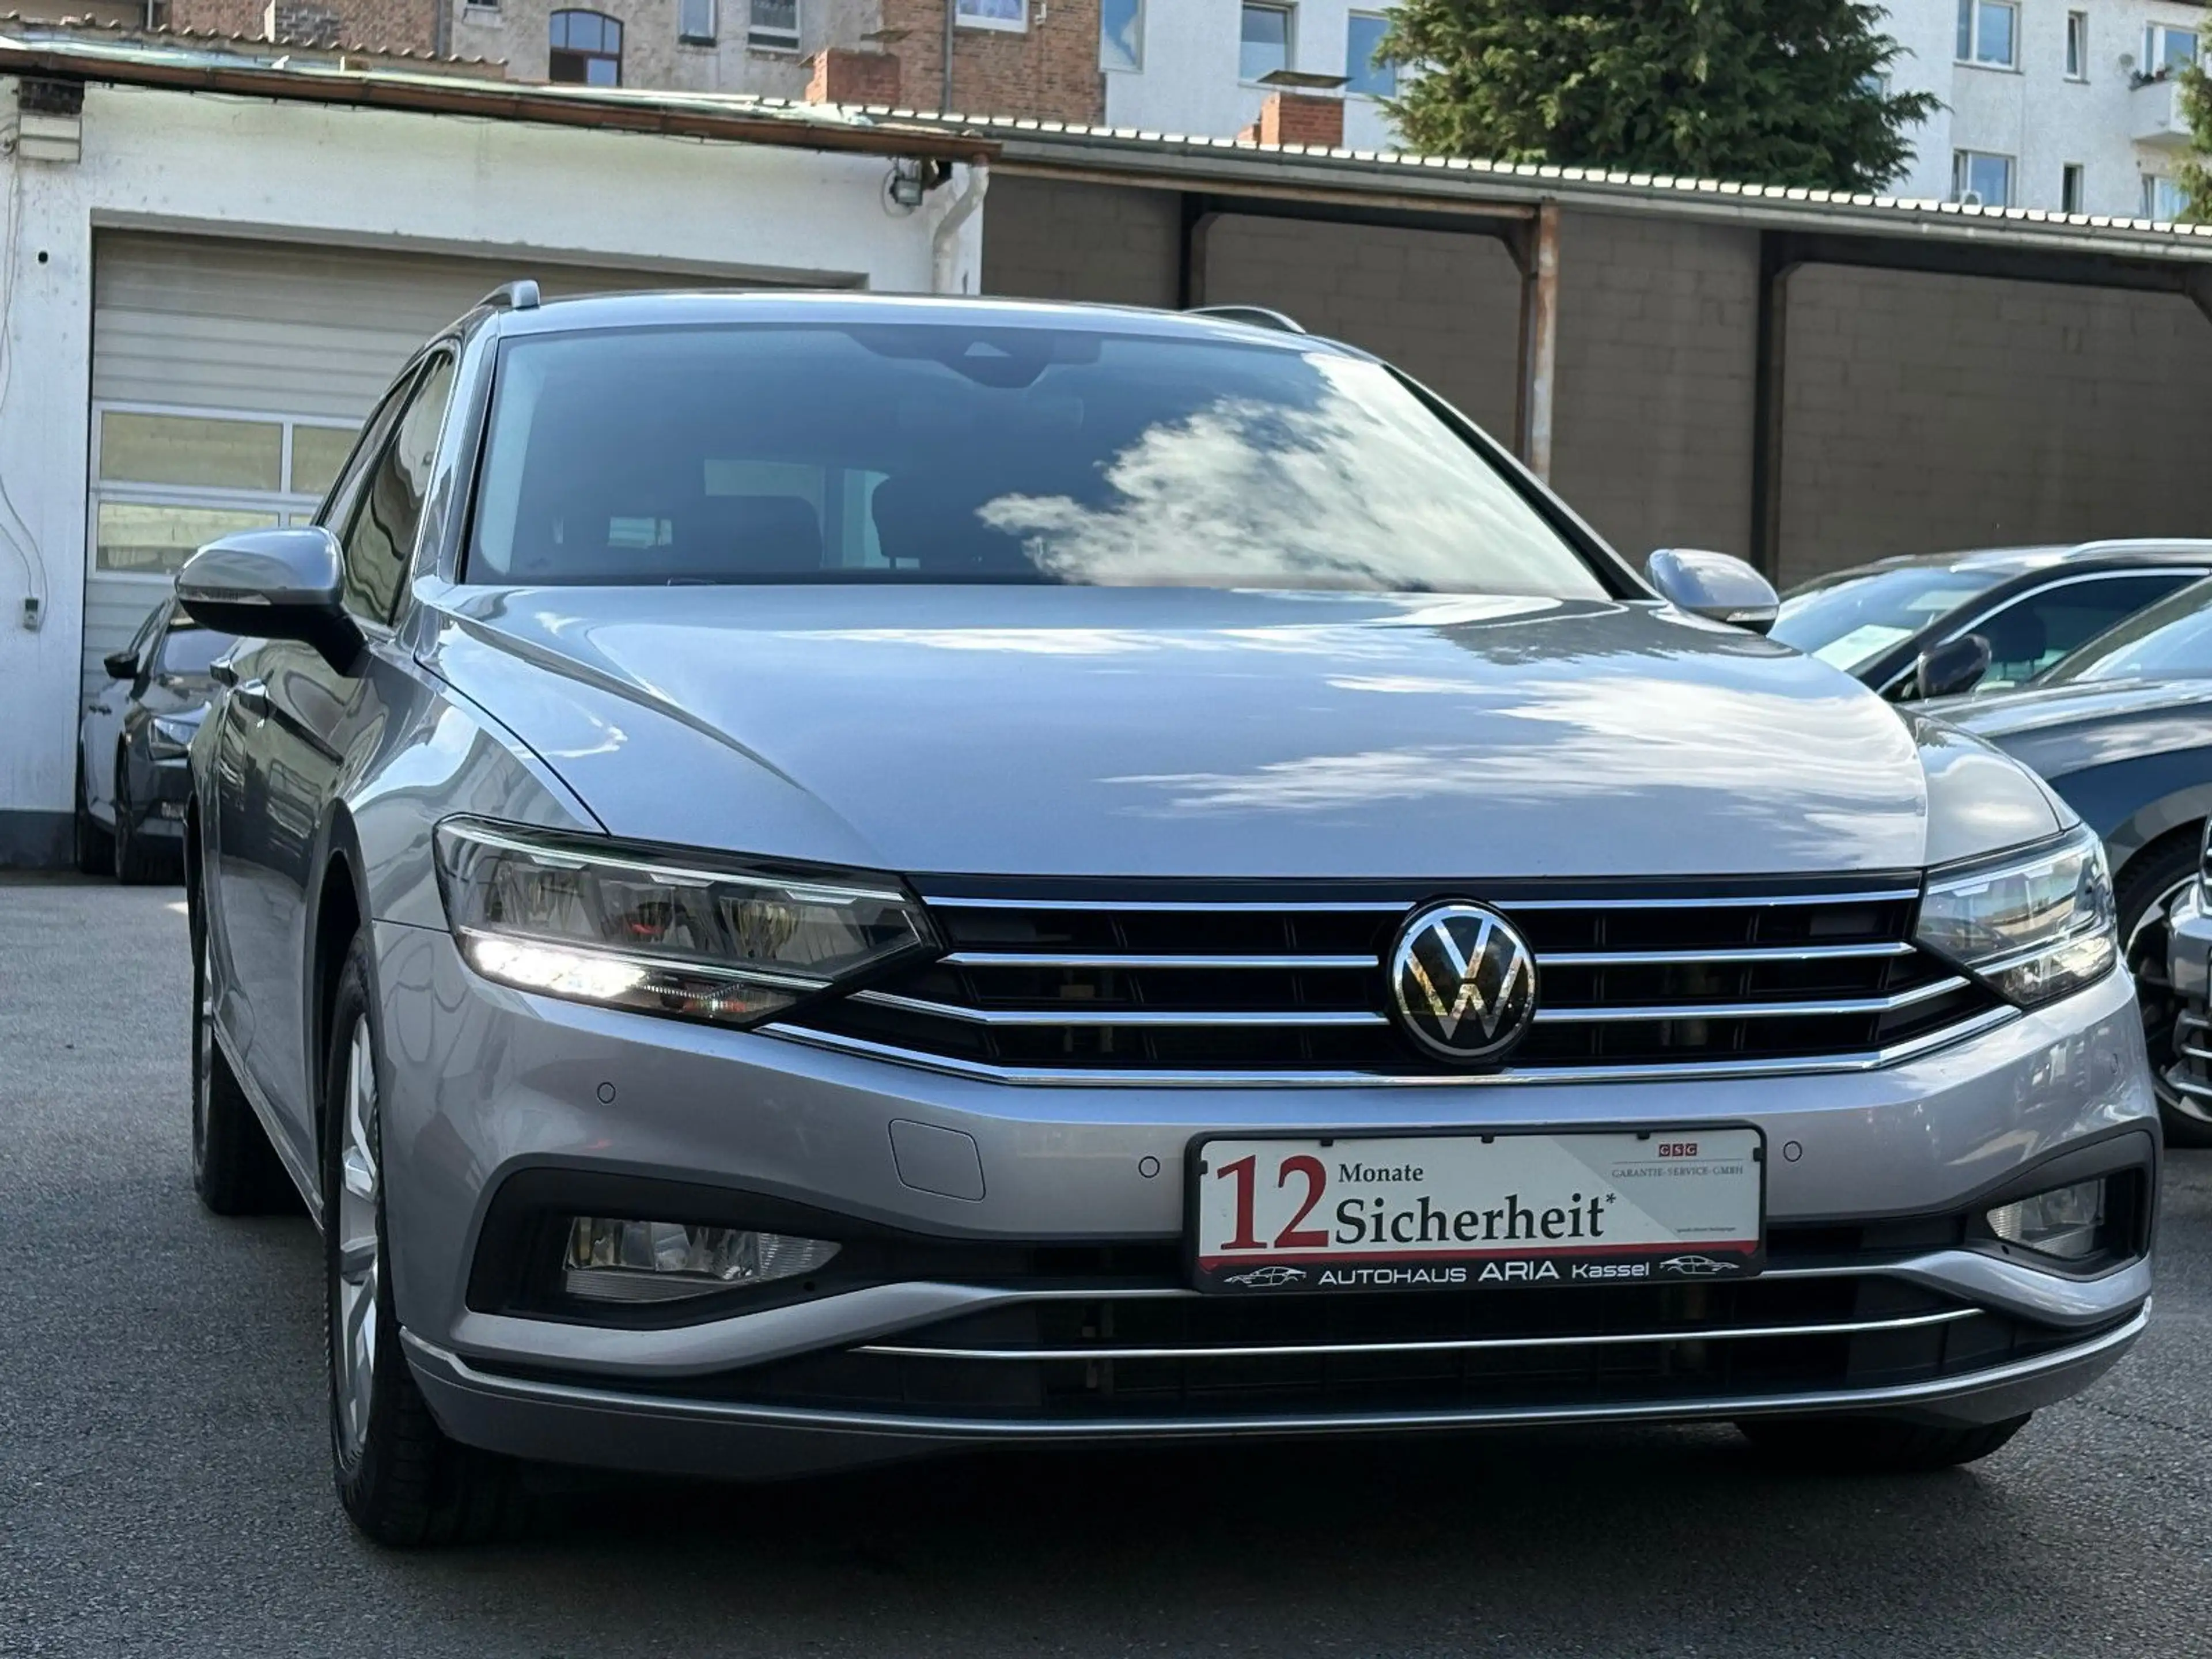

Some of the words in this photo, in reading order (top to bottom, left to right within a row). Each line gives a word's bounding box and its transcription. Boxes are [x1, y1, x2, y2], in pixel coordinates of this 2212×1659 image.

[1402, 911, 1528, 1043] VW
[1217, 1154, 1329, 1250] 12
[1338, 1162, 1424, 1183] Monate
[1318, 1268, 1467, 1285] AUTOHAUS
[1478, 1260, 1560, 1283] ARIA
[1571, 1262, 1649, 1279] Kassel
